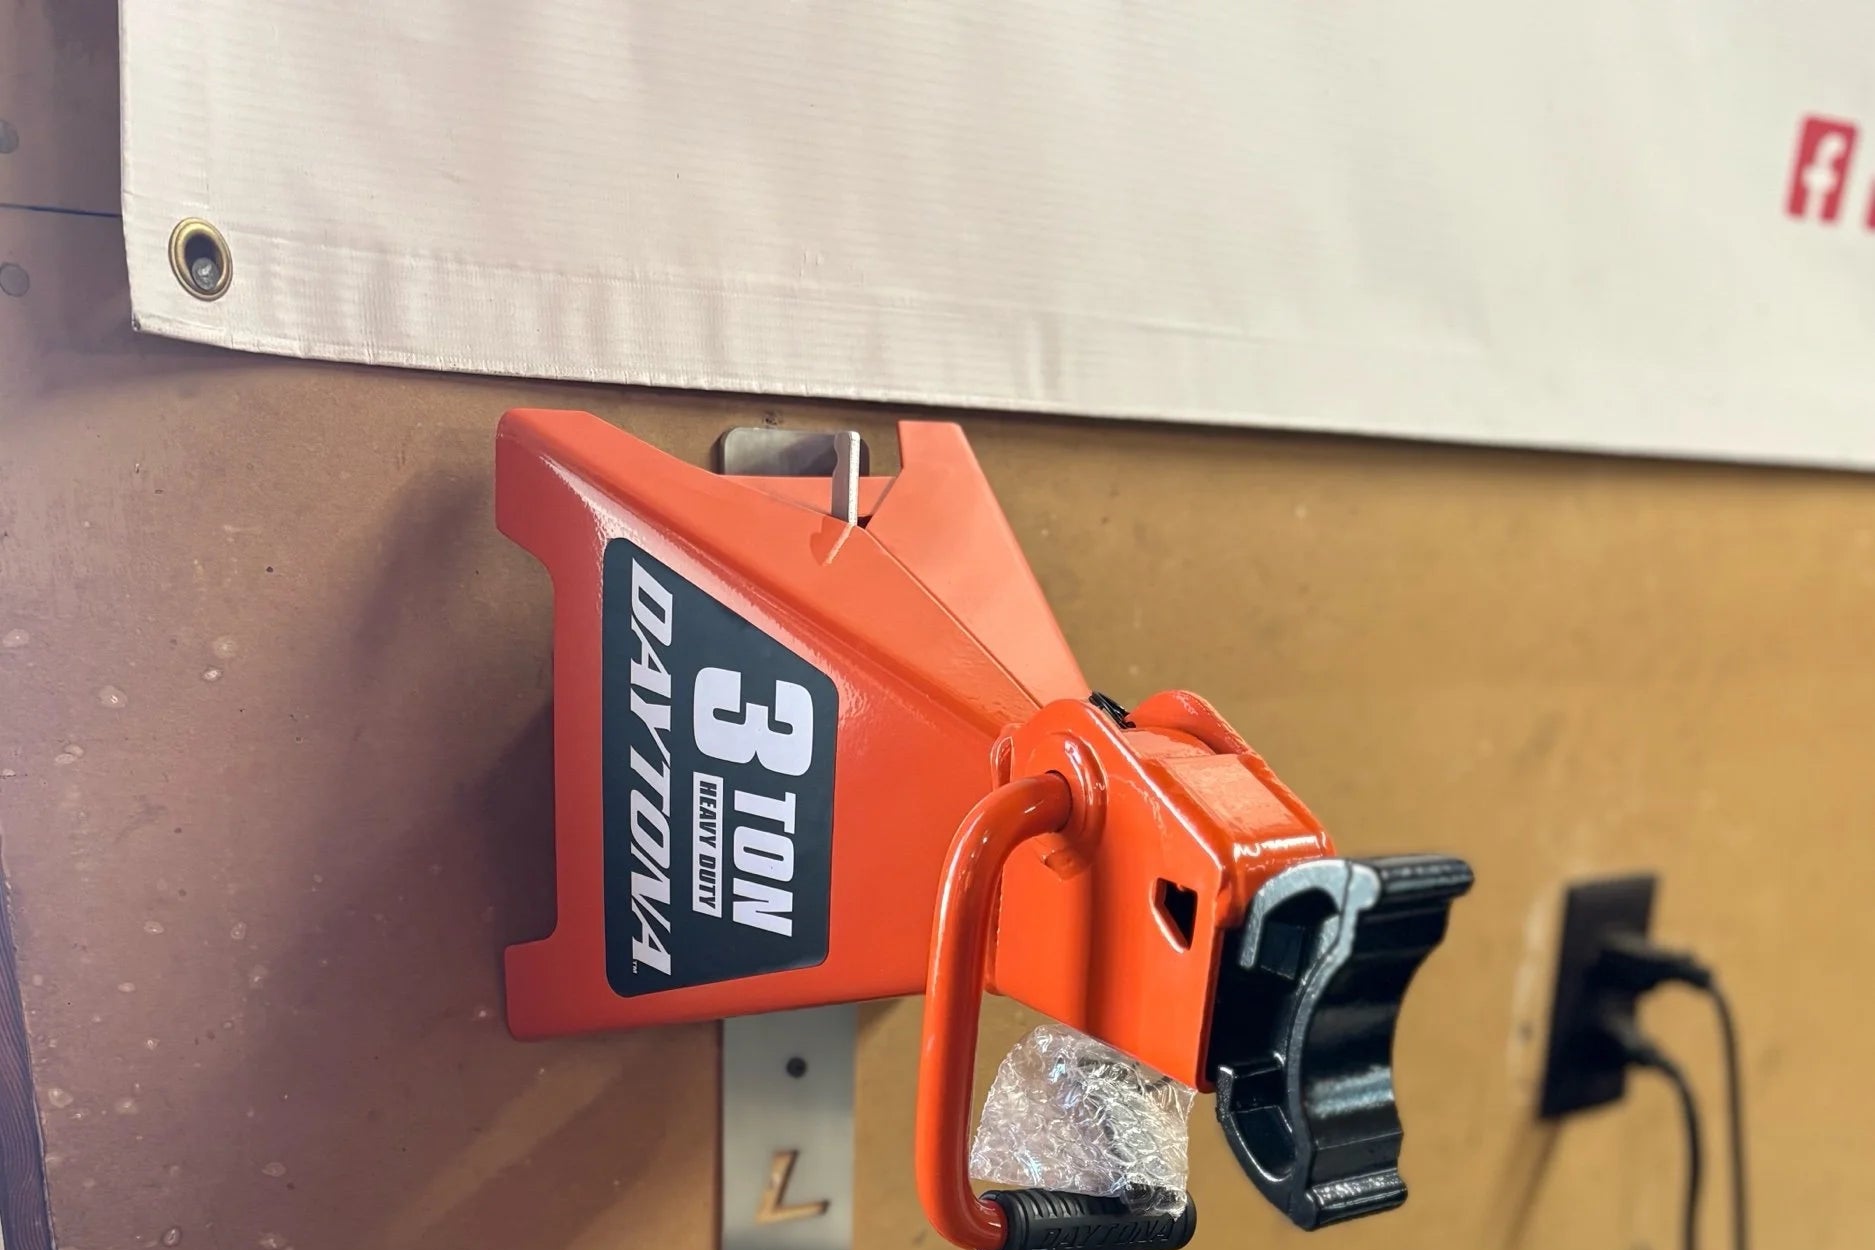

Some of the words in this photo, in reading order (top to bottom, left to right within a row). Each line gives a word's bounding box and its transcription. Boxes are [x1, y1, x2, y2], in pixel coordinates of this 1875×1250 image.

[693, 667, 814, 776] 3
[699, 781, 717, 848] HEAVY
[699, 853, 717, 909] DUTY
[733, 790, 794, 937] TON
[1034, 1219, 1171, 1250] DAYTONA
